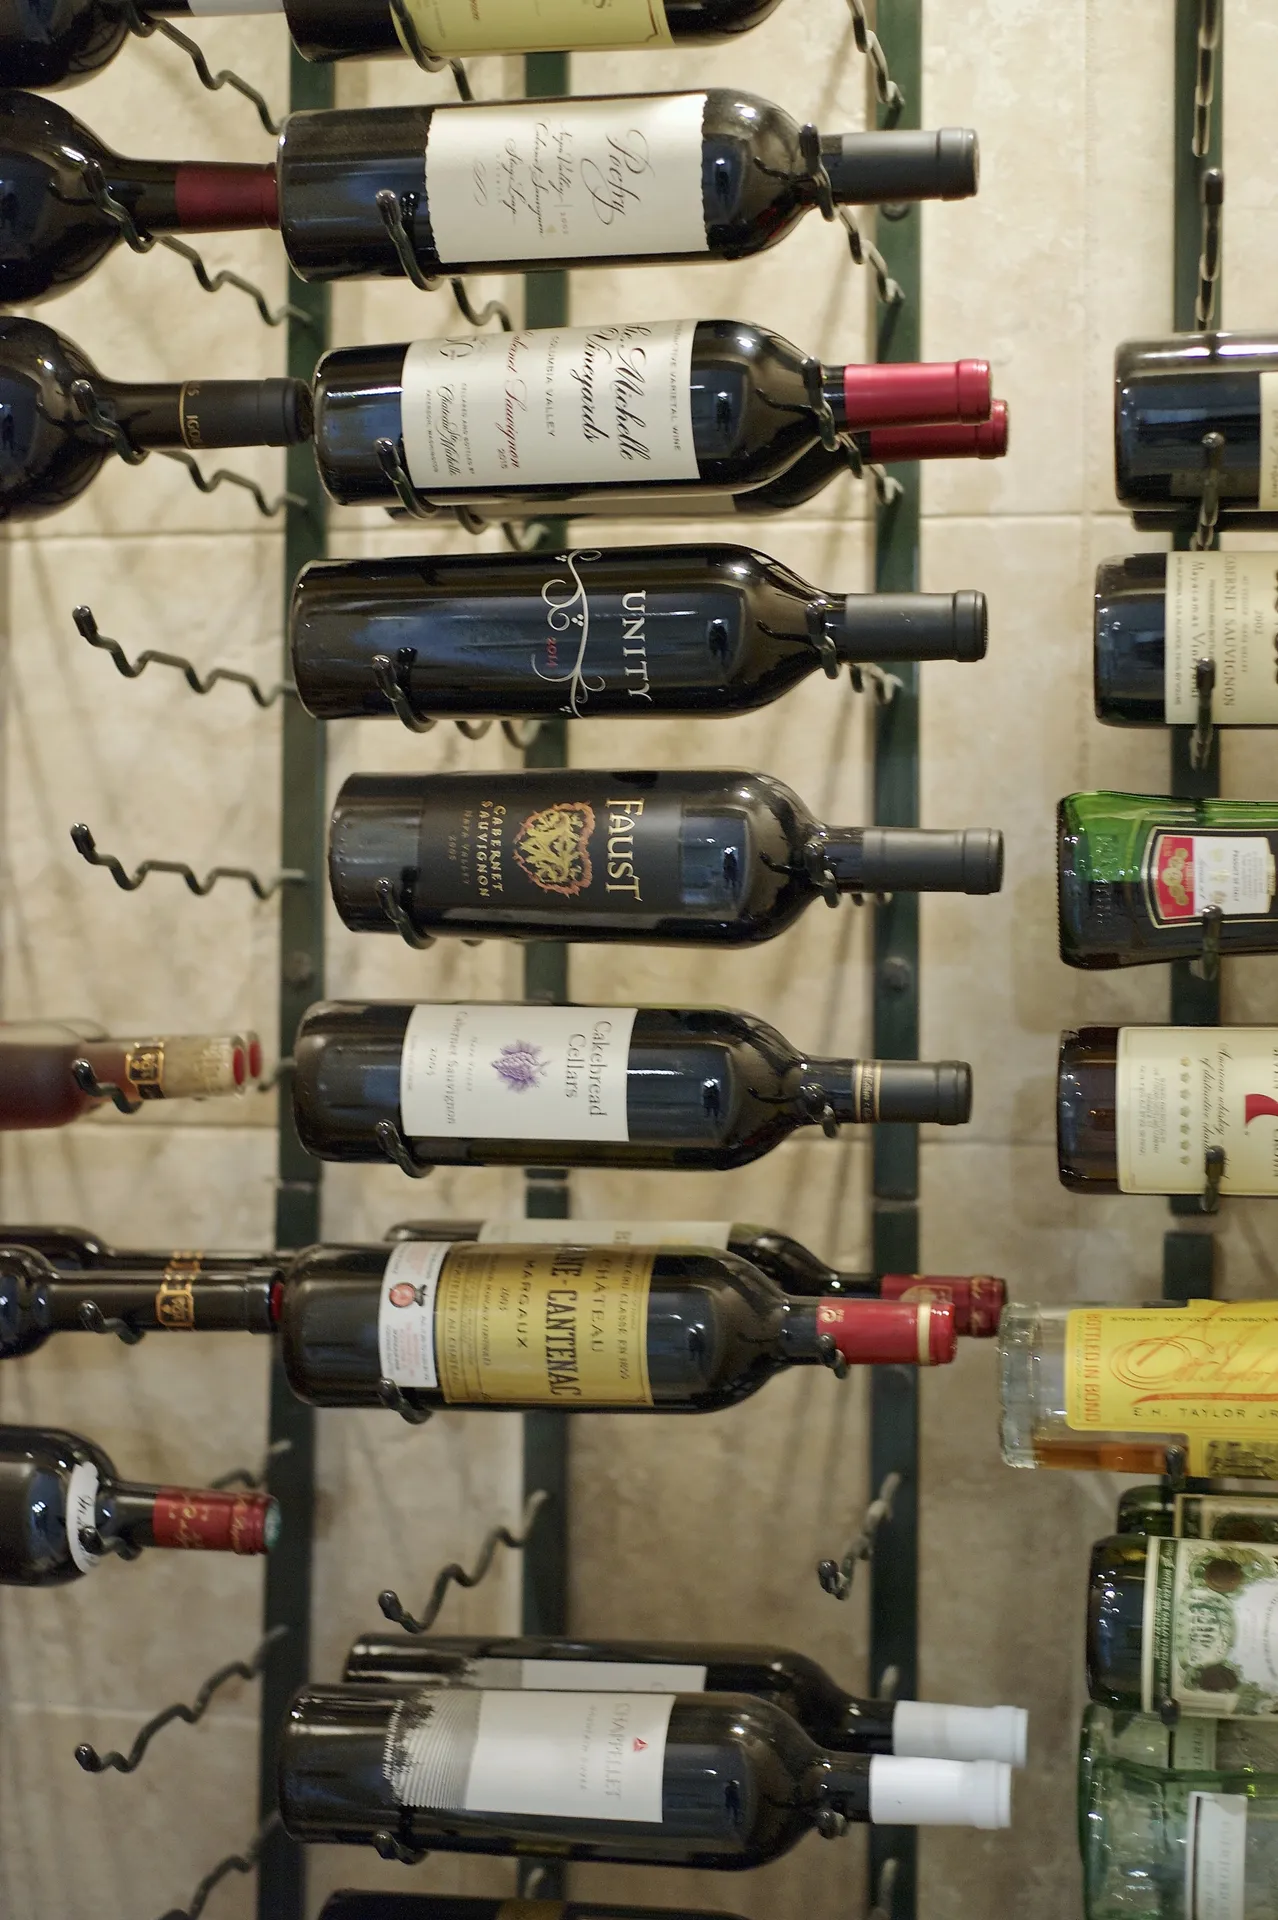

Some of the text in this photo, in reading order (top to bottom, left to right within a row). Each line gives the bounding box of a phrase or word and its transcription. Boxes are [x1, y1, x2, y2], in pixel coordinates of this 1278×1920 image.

[579, 129, 656, 225] Poetry
[495, 379, 528, 469] Sauvignon
[545, 390, 557, 438] VALLEY
[570, 328, 620, 444] Vineyards
[611, 348, 653, 461] Michelle
[673, 426, 682, 452] WINE
[545, 637, 559, 668] 2014
[622, 589, 653, 703] UNITY
[1222, 554, 1237, 707] CABERNET SAUVIGNON
[475, 800, 494, 898] SAUVIGNON
[488, 804, 507, 893] CABERNET
[604, 797, 645, 903] FAUST
[444, 1059, 460, 1125] Sauvignon
[565, 1032, 587, 1099] Cellars
[588, 1019, 613, 1117] Cakebread
[1217, 1043, 1233, 1093] American
[516, 1259, 535, 1349] MARGAUX
[1084, 1383, 1101, 1423] BOND
[1178, 1407, 1247, 1419] TAYLOR
